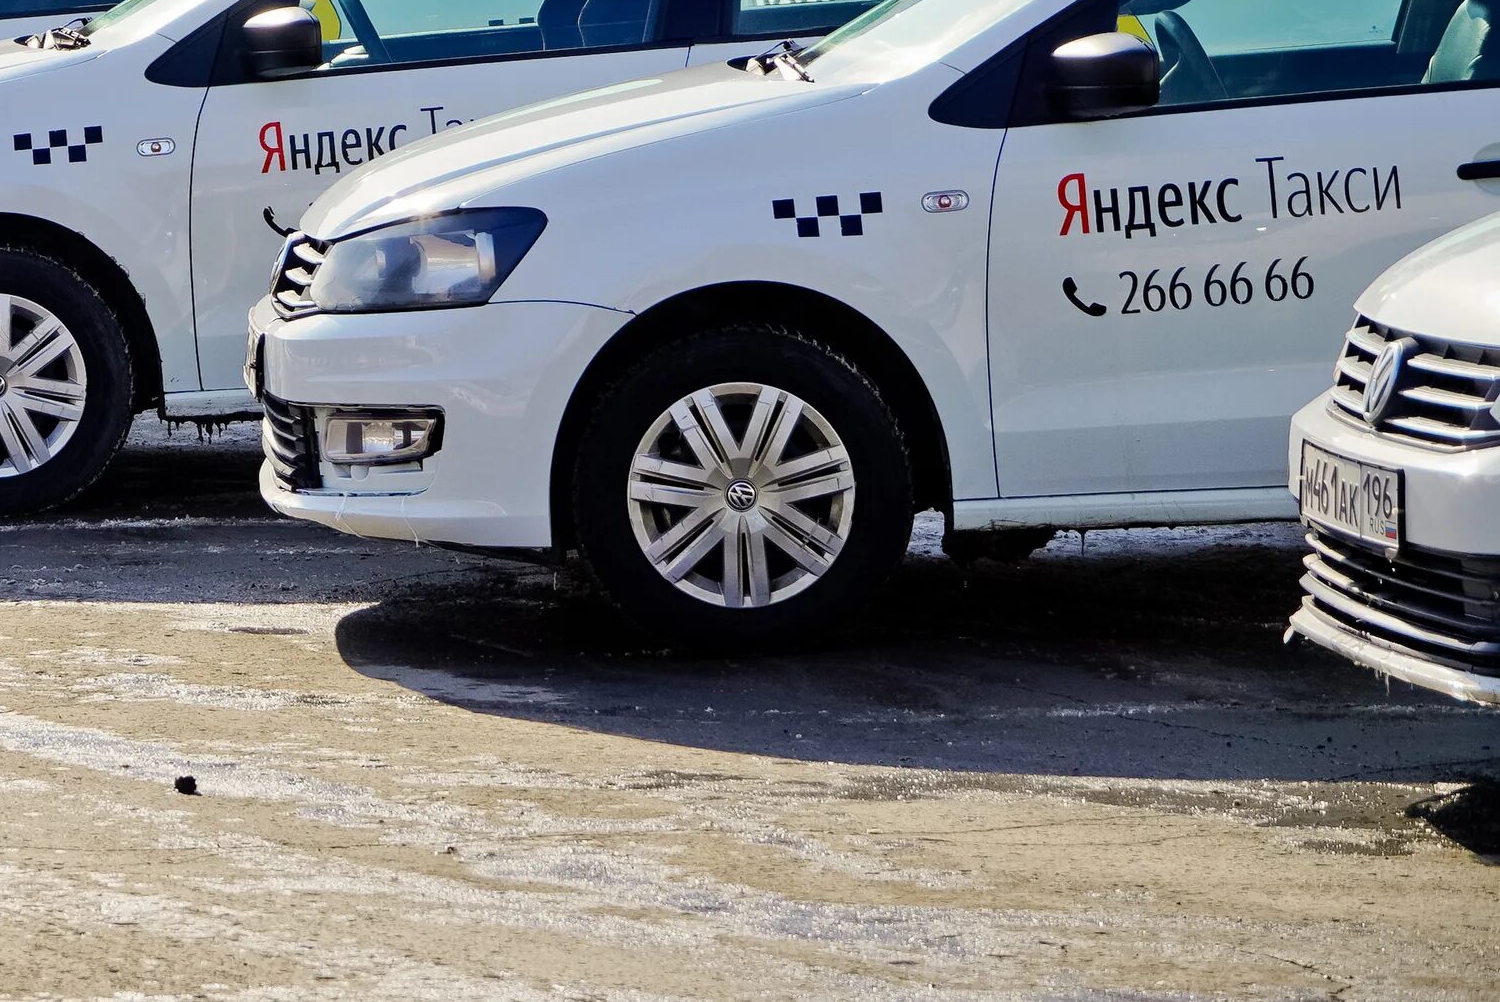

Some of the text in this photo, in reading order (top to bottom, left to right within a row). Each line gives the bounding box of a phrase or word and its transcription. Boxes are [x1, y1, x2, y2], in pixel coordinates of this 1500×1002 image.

[1058, 156, 1402, 239] Яндекс Такси
[1118, 256, 1314, 315] 266 66 66
[1363, 473, 1393, 519] 196
[1369, 518, 1385, 535] RUS
